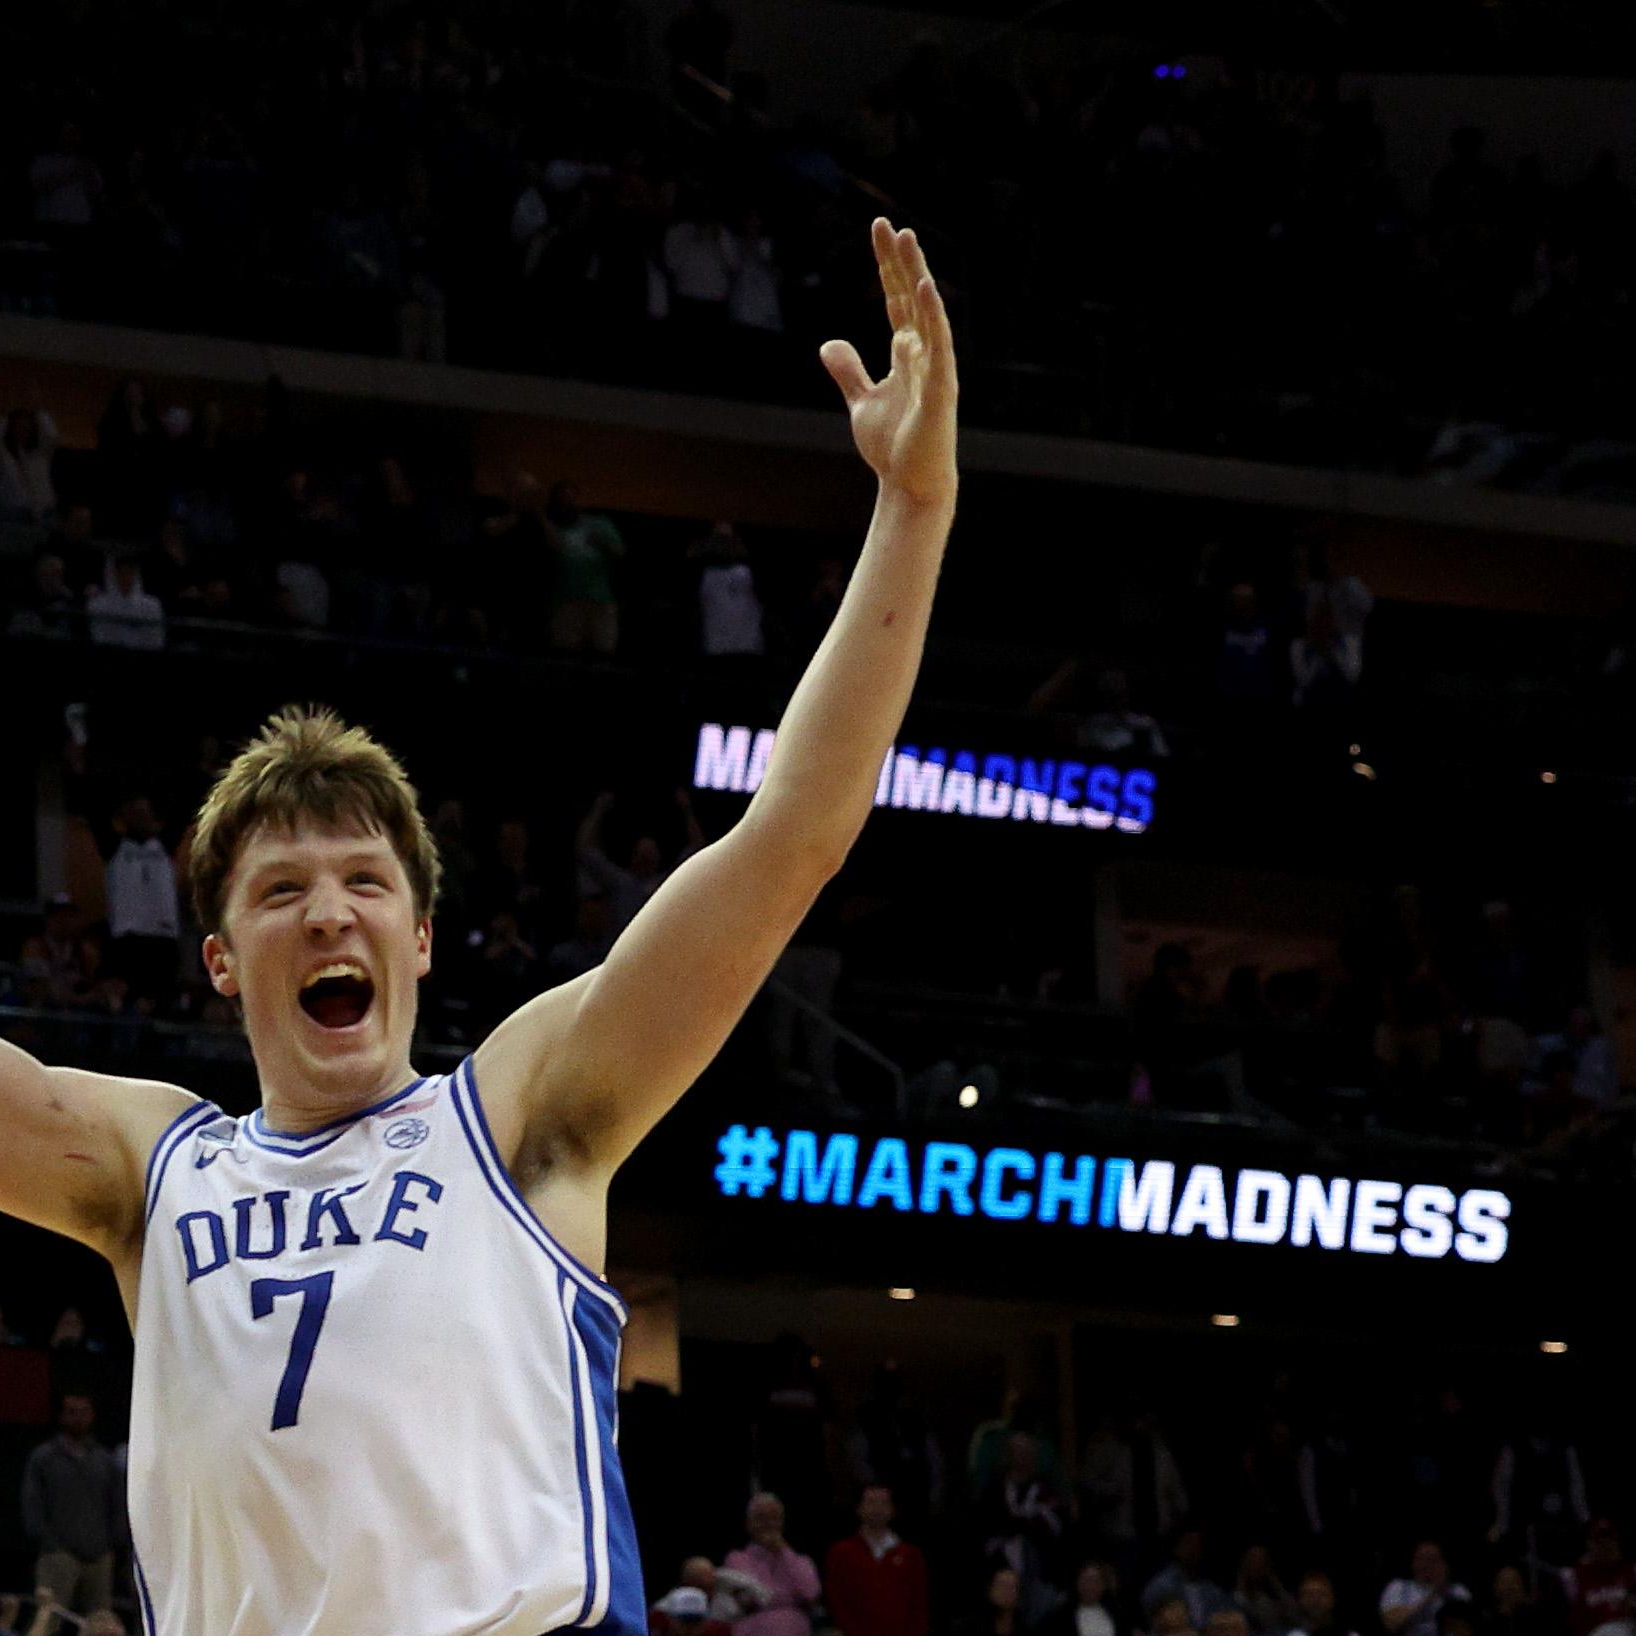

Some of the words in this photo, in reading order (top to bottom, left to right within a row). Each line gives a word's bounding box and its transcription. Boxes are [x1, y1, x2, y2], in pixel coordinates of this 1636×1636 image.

[176, 1170, 444, 1285] DUKE
[713, 1124, 1512, 1264] #MARCHMADNESS
[250, 1270, 335, 1432] 7
